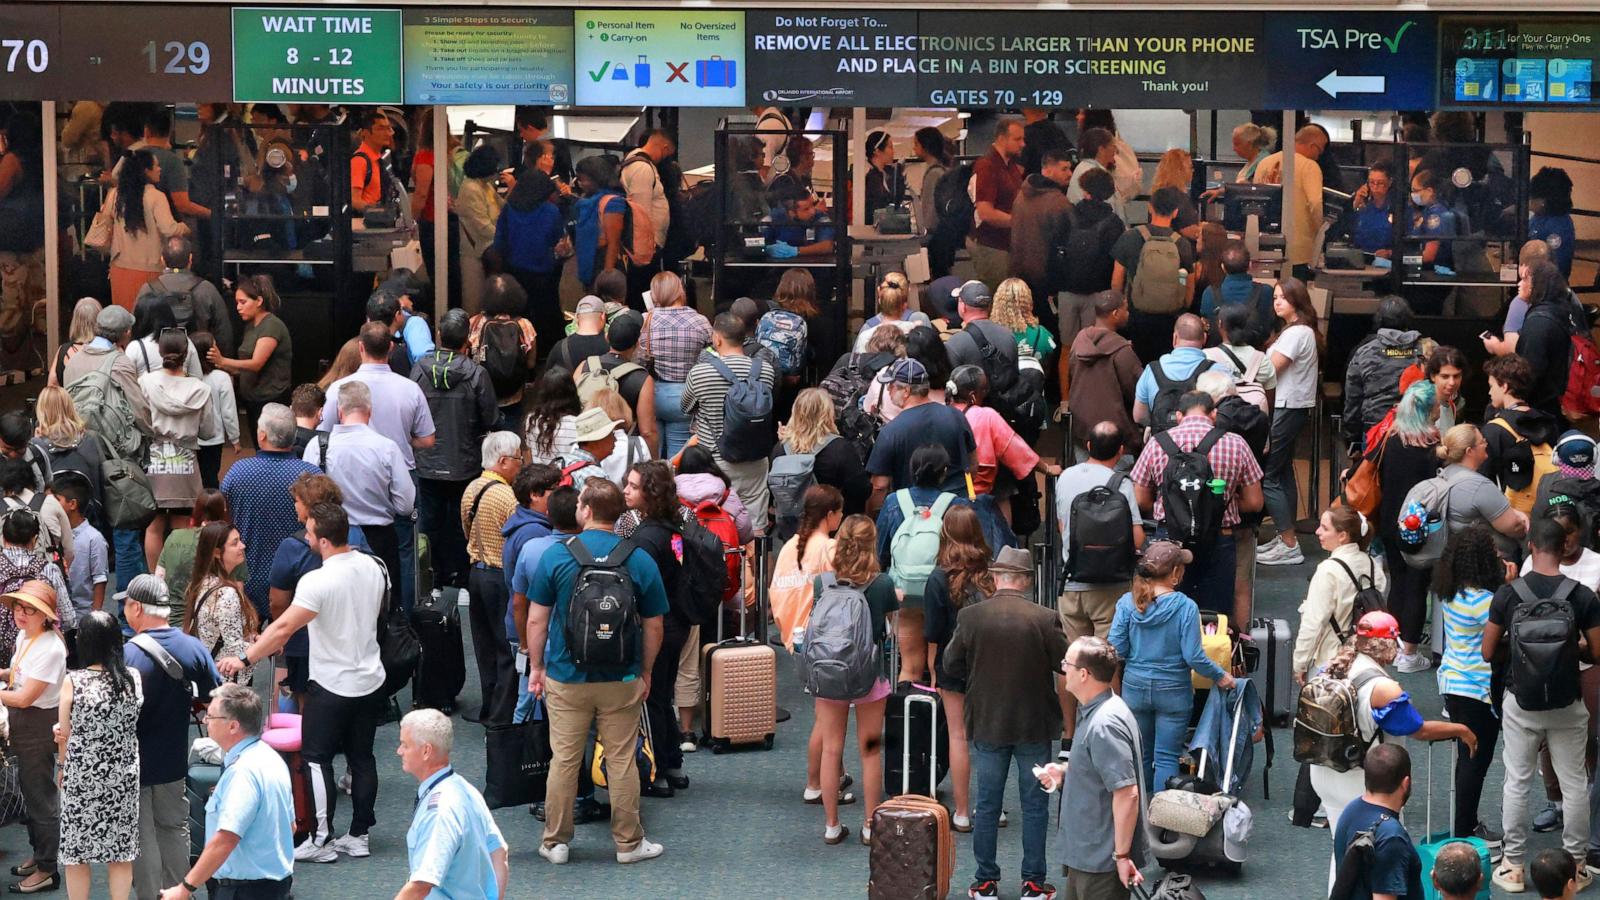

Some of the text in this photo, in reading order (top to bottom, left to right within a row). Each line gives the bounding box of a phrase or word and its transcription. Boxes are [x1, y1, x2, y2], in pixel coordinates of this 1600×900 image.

[262, 16, 372, 33] WAIT TIME
[432, 16, 462, 25] Simple
[464, 16, 488, 25] Steps
[501, 16, 538, 25] Security
[597, 21, 633, 29] Personal
[635, 21, 655, 29] Item
[680, 22, 736, 30] No Oversized
[775, 17, 887, 30] Do Not Forget To...
[610, 33, 647, 44] Carry-on
[697, 33, 720, 41] Items
[1297, 29, 1382, 49] TSA Pre
[1522, 34, 1544, 43] Your
[1545, 33, 1592, 45] Carry-Ons
[755, 35, 1255, 53] REMOVE ALL ELECTRONICS LARGER THAN YOUR PHONE
[2, 39, 49, 73] 70
[142, 40, 211, 75] 129
[286, 48, 299, 64] 8
[329, 48, 352, 65] 12
[837, 58, 1166, 75] AND PLACE IN A BIN FOR SCREENING
[272, 78, 364, 95] MINUTES
[454, 82, 483, 90] safety
[513, 82, 549, 91] priority
[1142, 81, 1209, 93] Thank you!
[930, 90, 988, 105] GATES
[994, 90, 1014, 105] 70
[1032, 90, 1063, 105] 129
